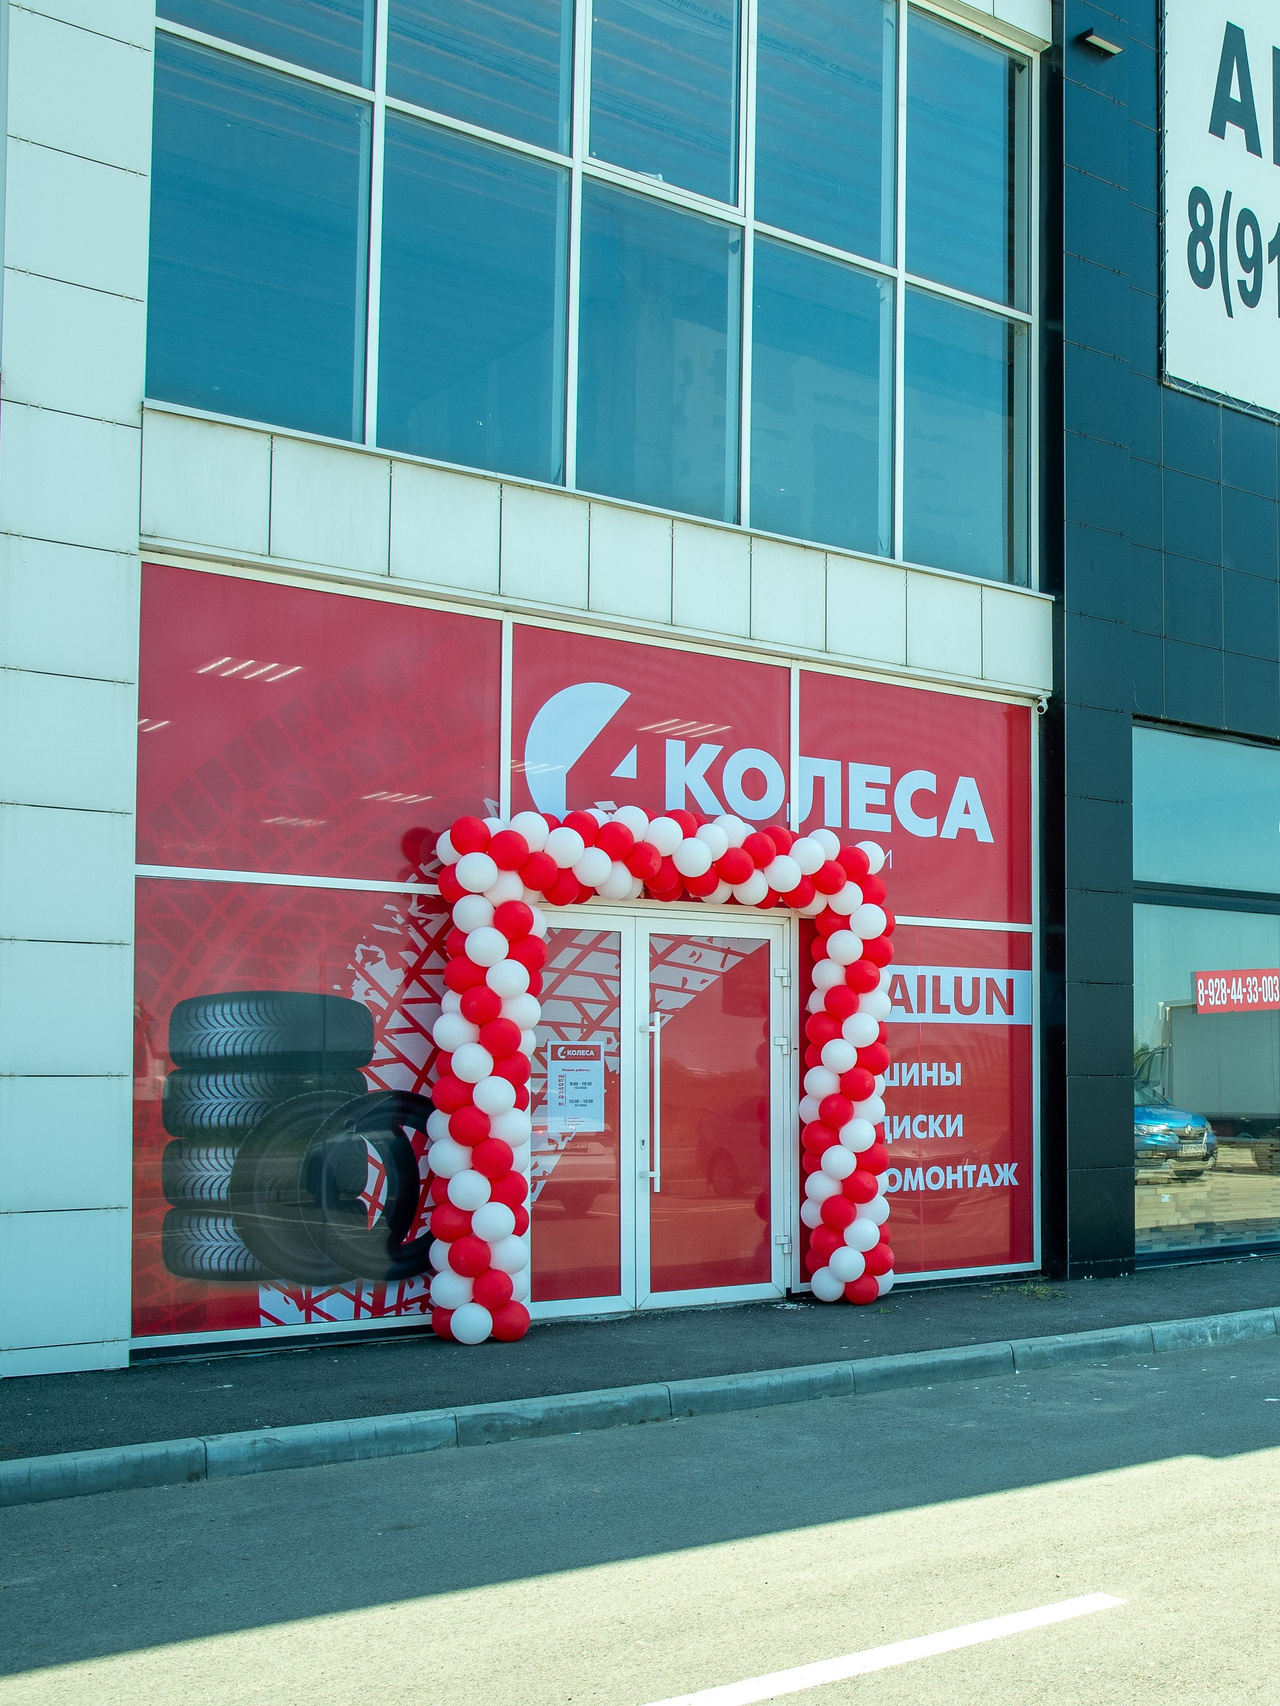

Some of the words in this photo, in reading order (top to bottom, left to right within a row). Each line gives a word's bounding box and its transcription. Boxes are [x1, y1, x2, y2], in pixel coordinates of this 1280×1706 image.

[665, 739, 994, 844] КОЛЕСА
[890, 974, 1014, 1016] AILUN
[1198, 976, 1280, 1006] 8-928-44-33-003
[886, 1162, 1018, 1192] ОМОНТАЖ
